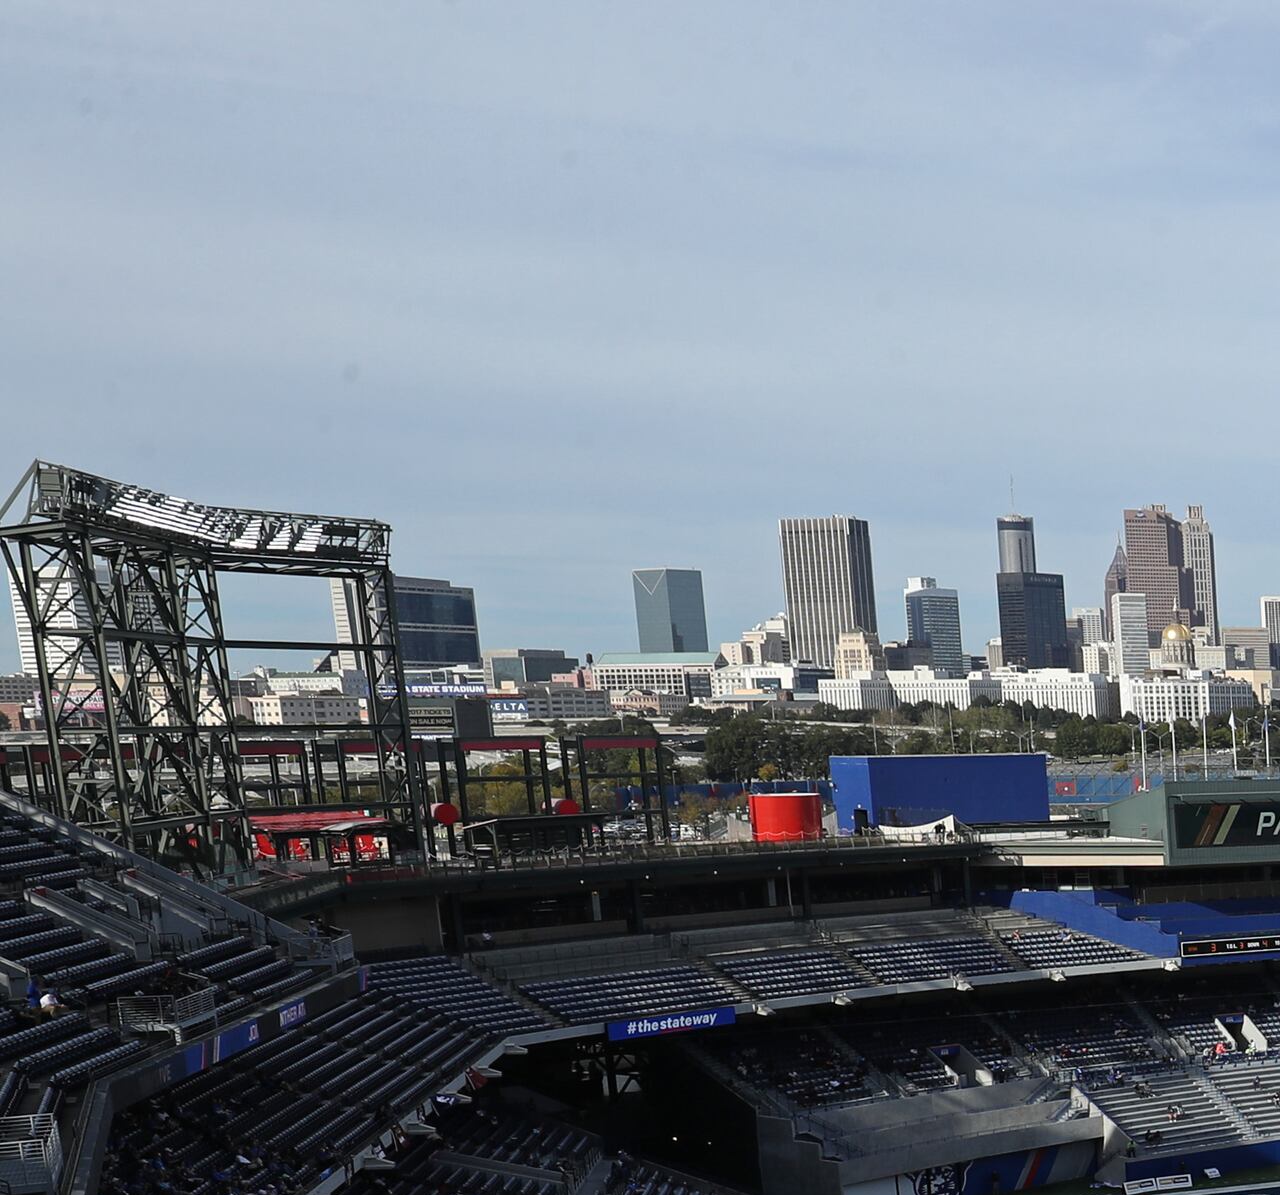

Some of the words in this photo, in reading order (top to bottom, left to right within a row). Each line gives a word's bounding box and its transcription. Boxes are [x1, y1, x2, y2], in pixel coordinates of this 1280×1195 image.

[412, 685, 441, 694] STATE
[442, 685, 484, 693] STADIUM
[1211, 943, 1216, 952] 3
[626, 1012, 718, 1034] #thestateway
